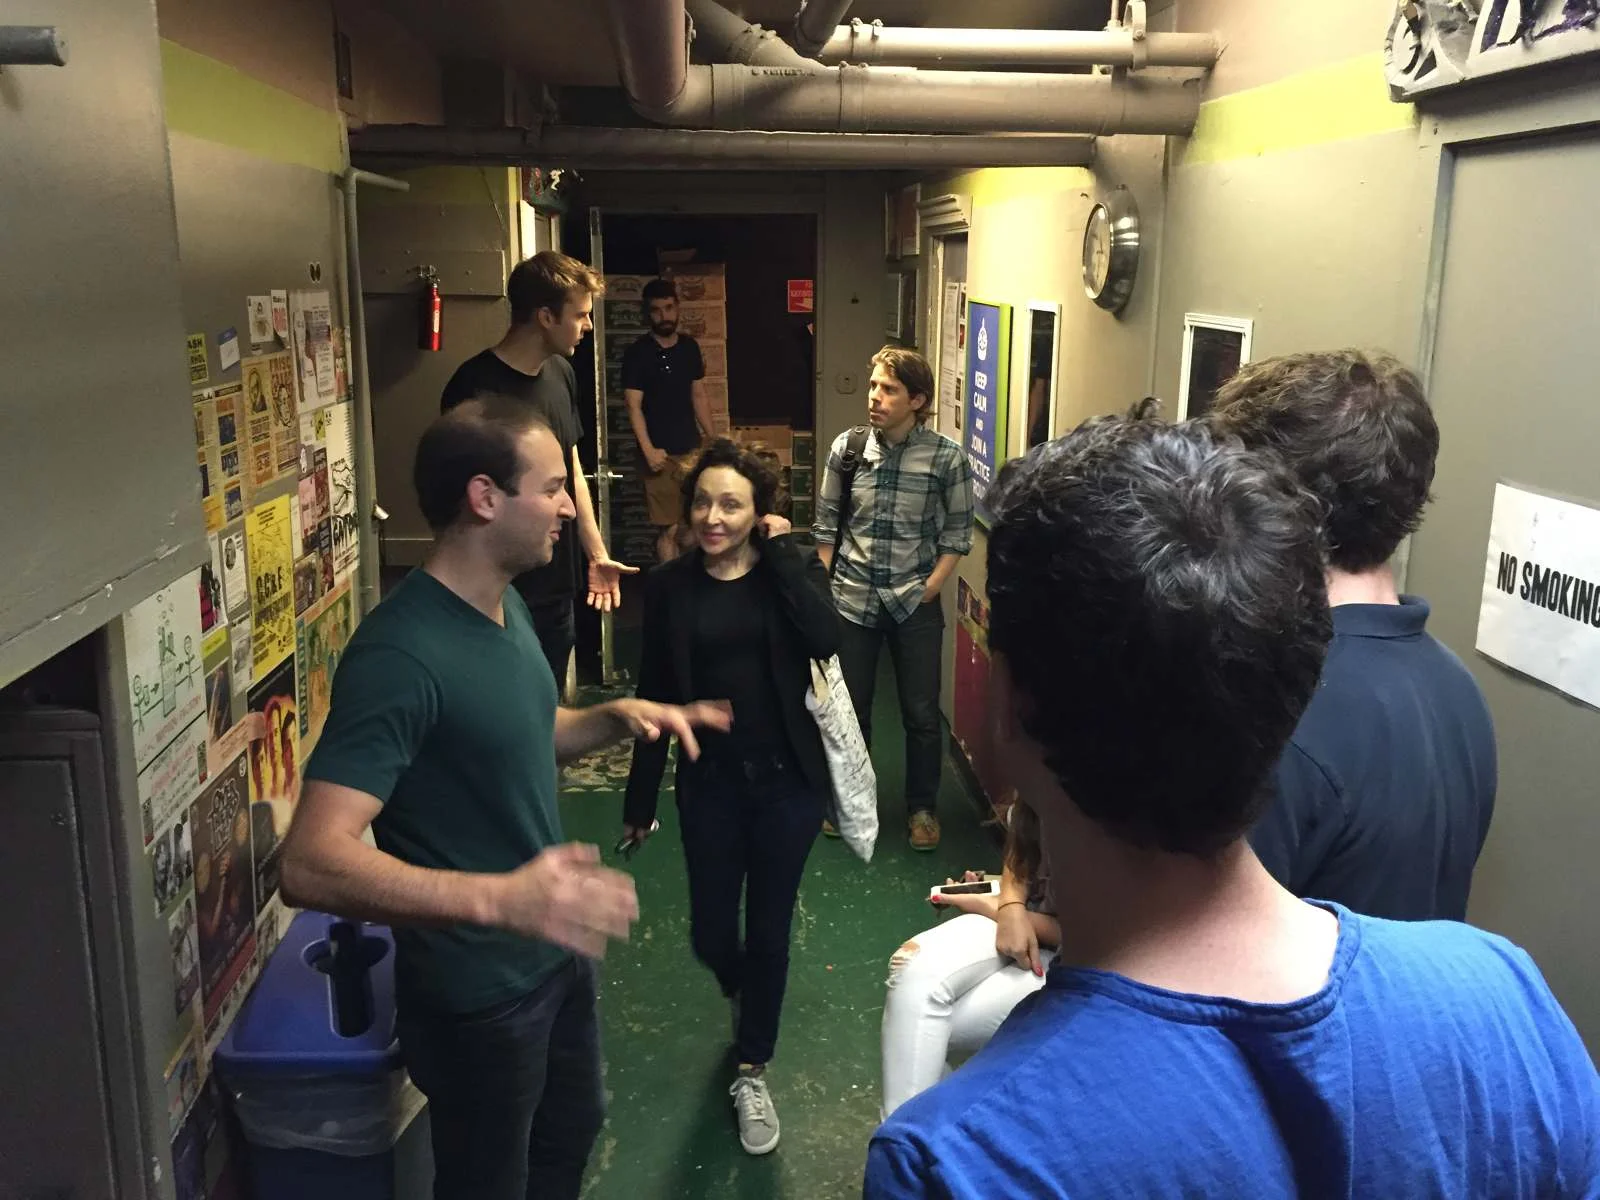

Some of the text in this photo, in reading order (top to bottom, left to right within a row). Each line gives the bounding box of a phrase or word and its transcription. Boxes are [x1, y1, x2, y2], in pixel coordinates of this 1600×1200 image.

[975, 371, 988, 390] KEEP
[974, 392, 987, 412] CALM
[971, 434, 982, 454] JOIN
[968, 453, 990, 482] PRACTICE
[1497, 551, 1600, 628] NO SMOKING
